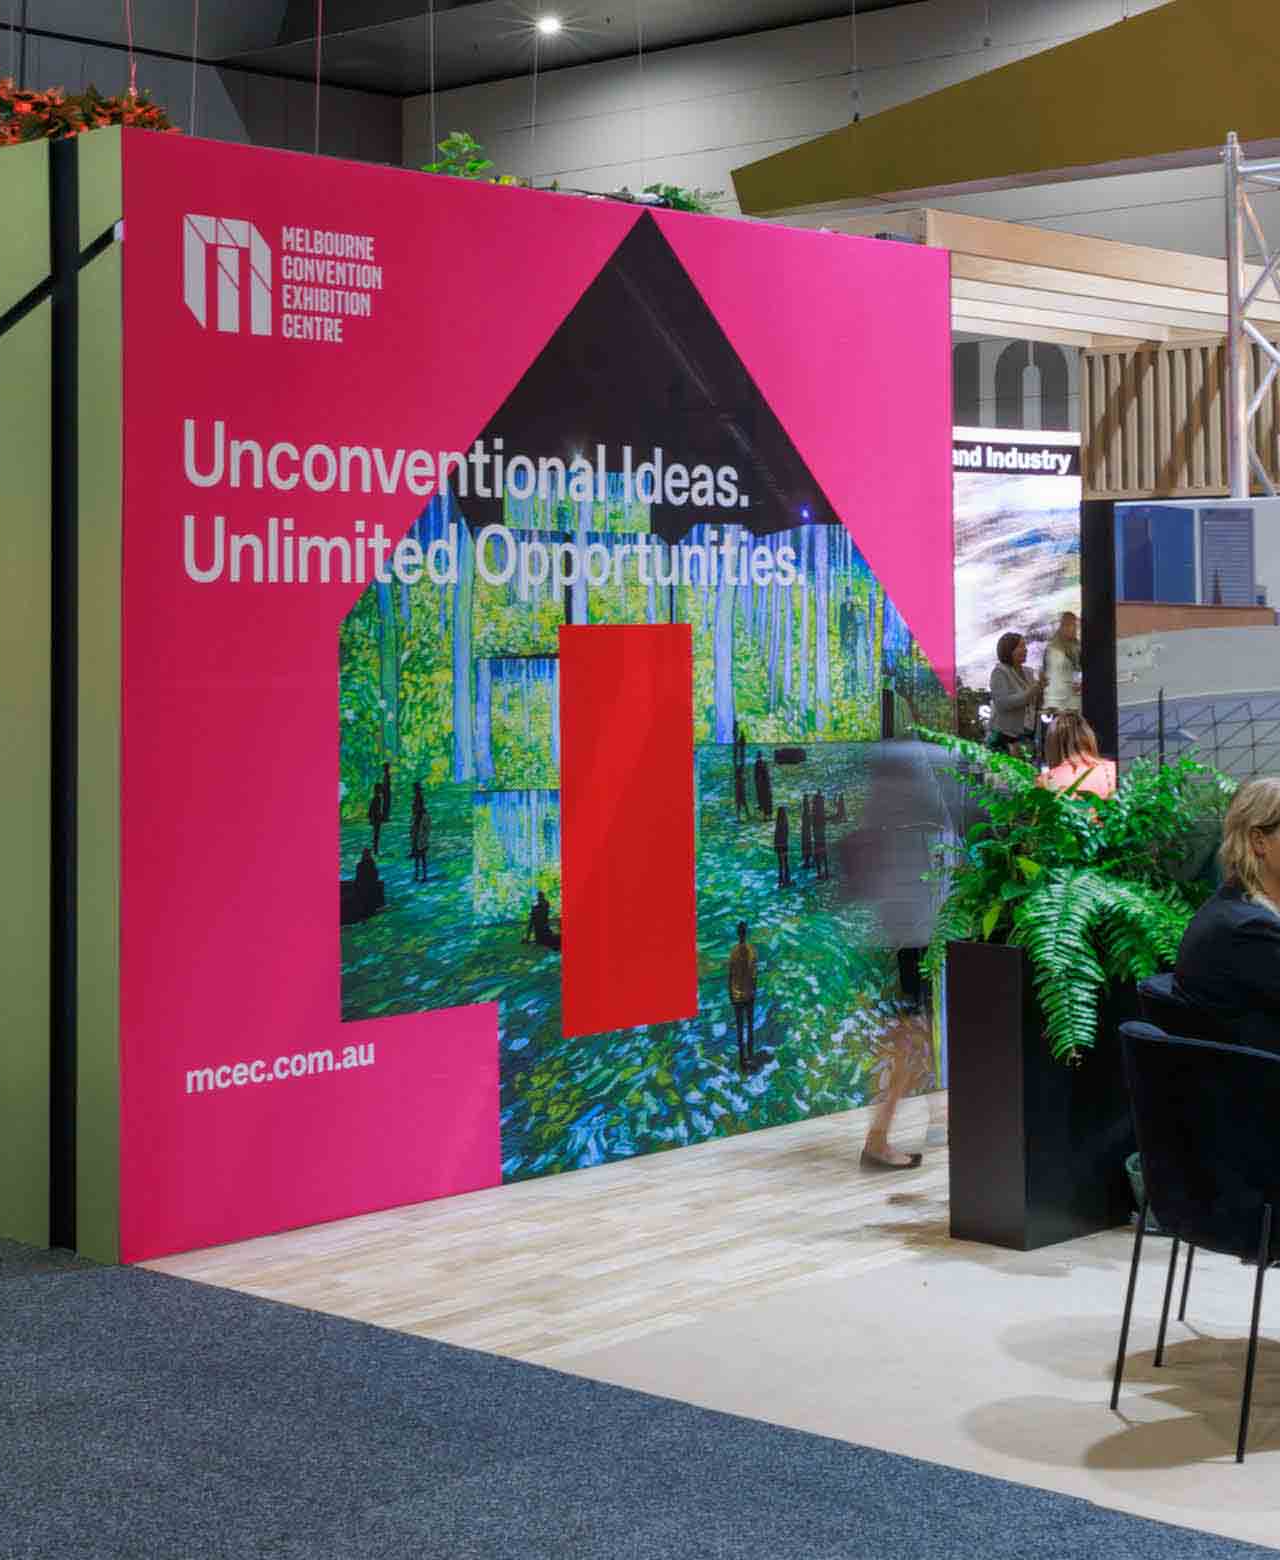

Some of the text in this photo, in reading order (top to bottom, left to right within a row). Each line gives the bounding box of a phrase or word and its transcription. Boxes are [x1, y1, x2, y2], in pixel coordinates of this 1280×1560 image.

[281, 226, 375, 260] MELBOURNE
[281, 255, 383, 289] CONVENTION
[281, 284, 371, 316] EXHIBITION
[281, 313, 343, 342] CENTRE
[184, 418, 750, 507] Unconventional Ideas.
[986, 446, 1072, 475] Industry
[184, 514, 806, 601] Unlimited Opportunities.
[185, 1042, 375, 1094] mcec.com.au
